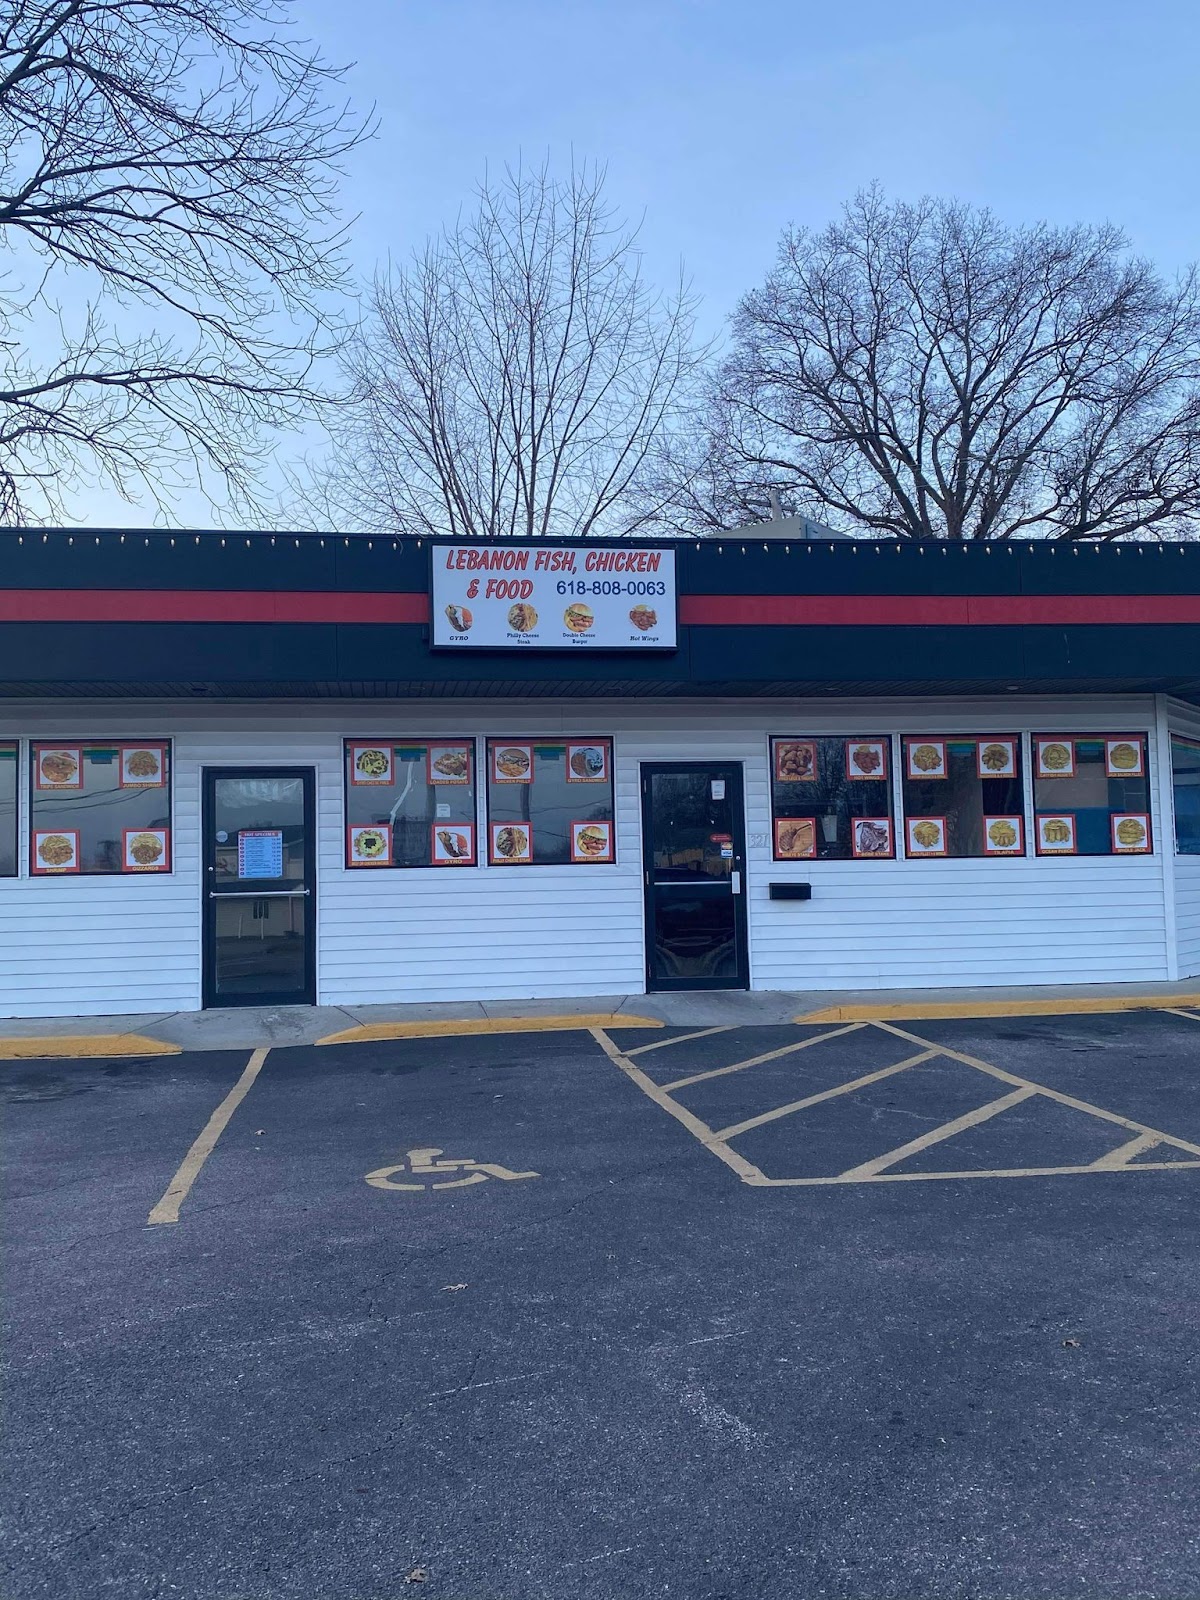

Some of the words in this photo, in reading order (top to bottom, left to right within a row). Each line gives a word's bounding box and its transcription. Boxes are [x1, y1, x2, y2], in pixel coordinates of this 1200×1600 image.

[446, 549, 529, 570] LEBANON
[535, 551, 577, 575] FISH,
[585, 551, 661, 572] CHICKEN
[467, 578, 480, 599] &
[486, 579, 534, 599] FOOD
[556, 580, 666, 596] 618-808-0063
